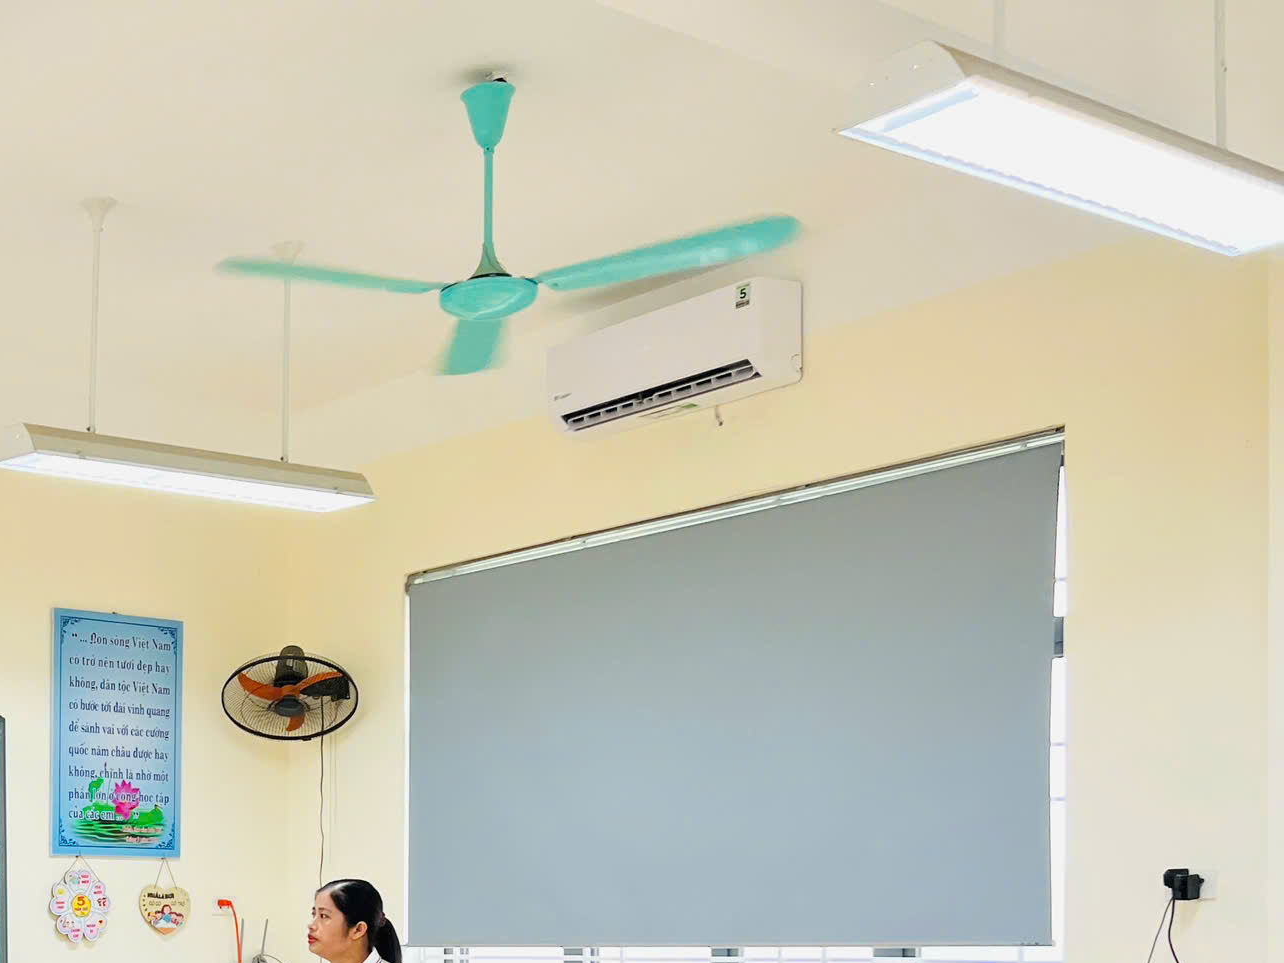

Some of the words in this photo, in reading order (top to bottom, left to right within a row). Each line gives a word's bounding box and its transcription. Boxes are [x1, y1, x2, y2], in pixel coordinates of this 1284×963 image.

[740, 288, 747, 299] 5
[152, 639, 171, 652] Nam
[156, 661, 170, 676] hay
[152, 683, 170, 695] Nam
[146, 708, 170, 719] quang
[102, 724, 114, 735] vai
[154, 748, 169, 762] hay
